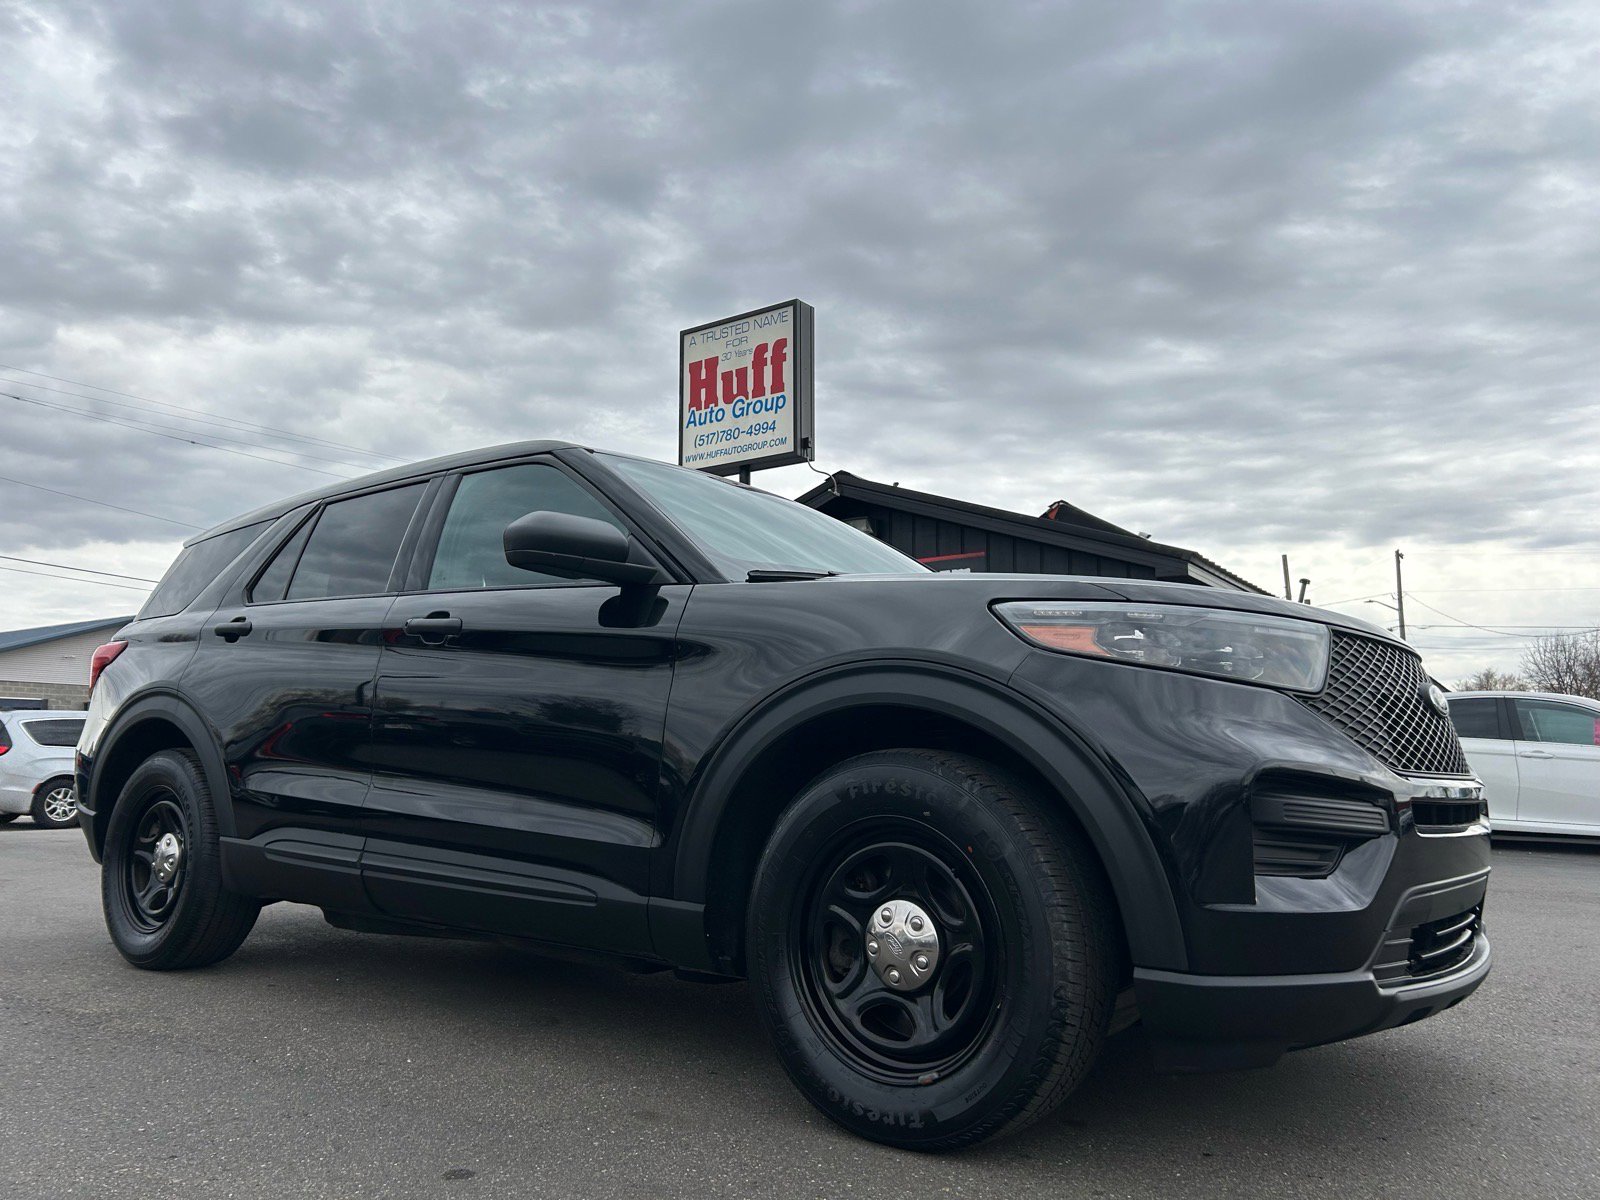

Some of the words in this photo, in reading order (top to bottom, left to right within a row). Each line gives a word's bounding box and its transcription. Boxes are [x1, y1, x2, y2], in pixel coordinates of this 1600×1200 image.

[689, 336, 697, 348] A
[701, 321, 750, 344] TRUSTED
[753, 310, 789, 329] NAME
[725, 336, 749, 349] FOR
[721, 350, 732, 362] 30
[734, 347, 754, 358] Years
[688, 337, 788, 412] Huff
[685, 405, 726, 429] Auto
[731, 394, 787, 419] Group
[694, 420, 777, 449] (517)780-4994
[684, 436, 788, 464] WWW.HUFFAUTOGROUP.COM
